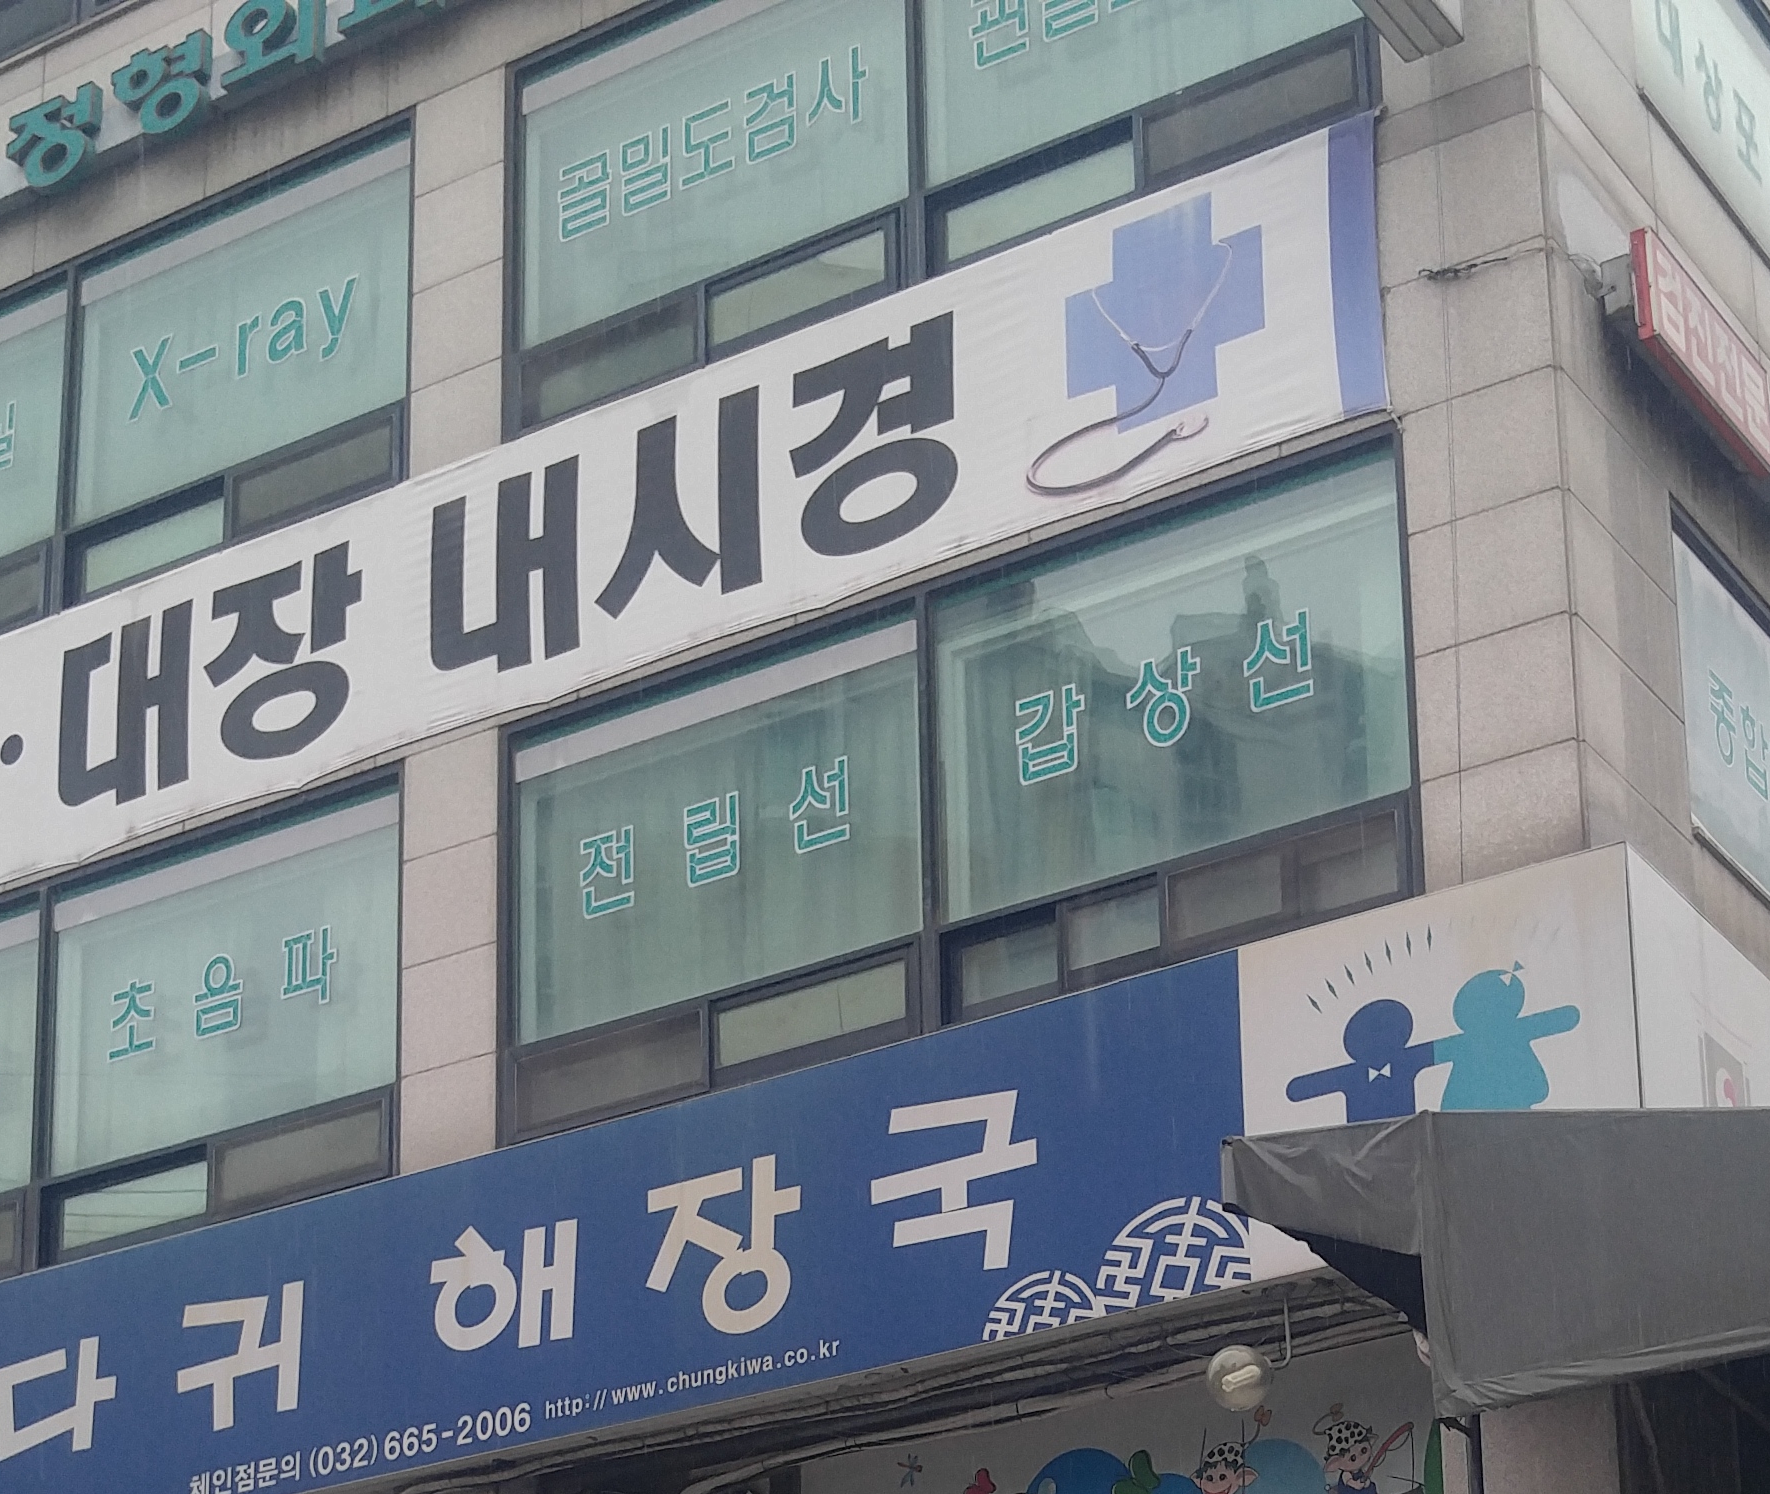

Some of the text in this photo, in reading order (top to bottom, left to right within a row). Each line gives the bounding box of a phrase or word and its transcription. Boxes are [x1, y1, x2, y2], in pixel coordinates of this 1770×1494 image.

[6, 0, 444, 189] 정형외
[556, 43, 869, 242] 골밀도검사
[129, 273, 359, 421] X-ray
[430, 311, 959, 674] 내시경
[1015, 608, 1314, 785] 갑상선
[577, 754, 851, 920] 전립선
[107, 925, 337, 1062] 초음파
[430, 1089, 1038, 1351] 해장국
